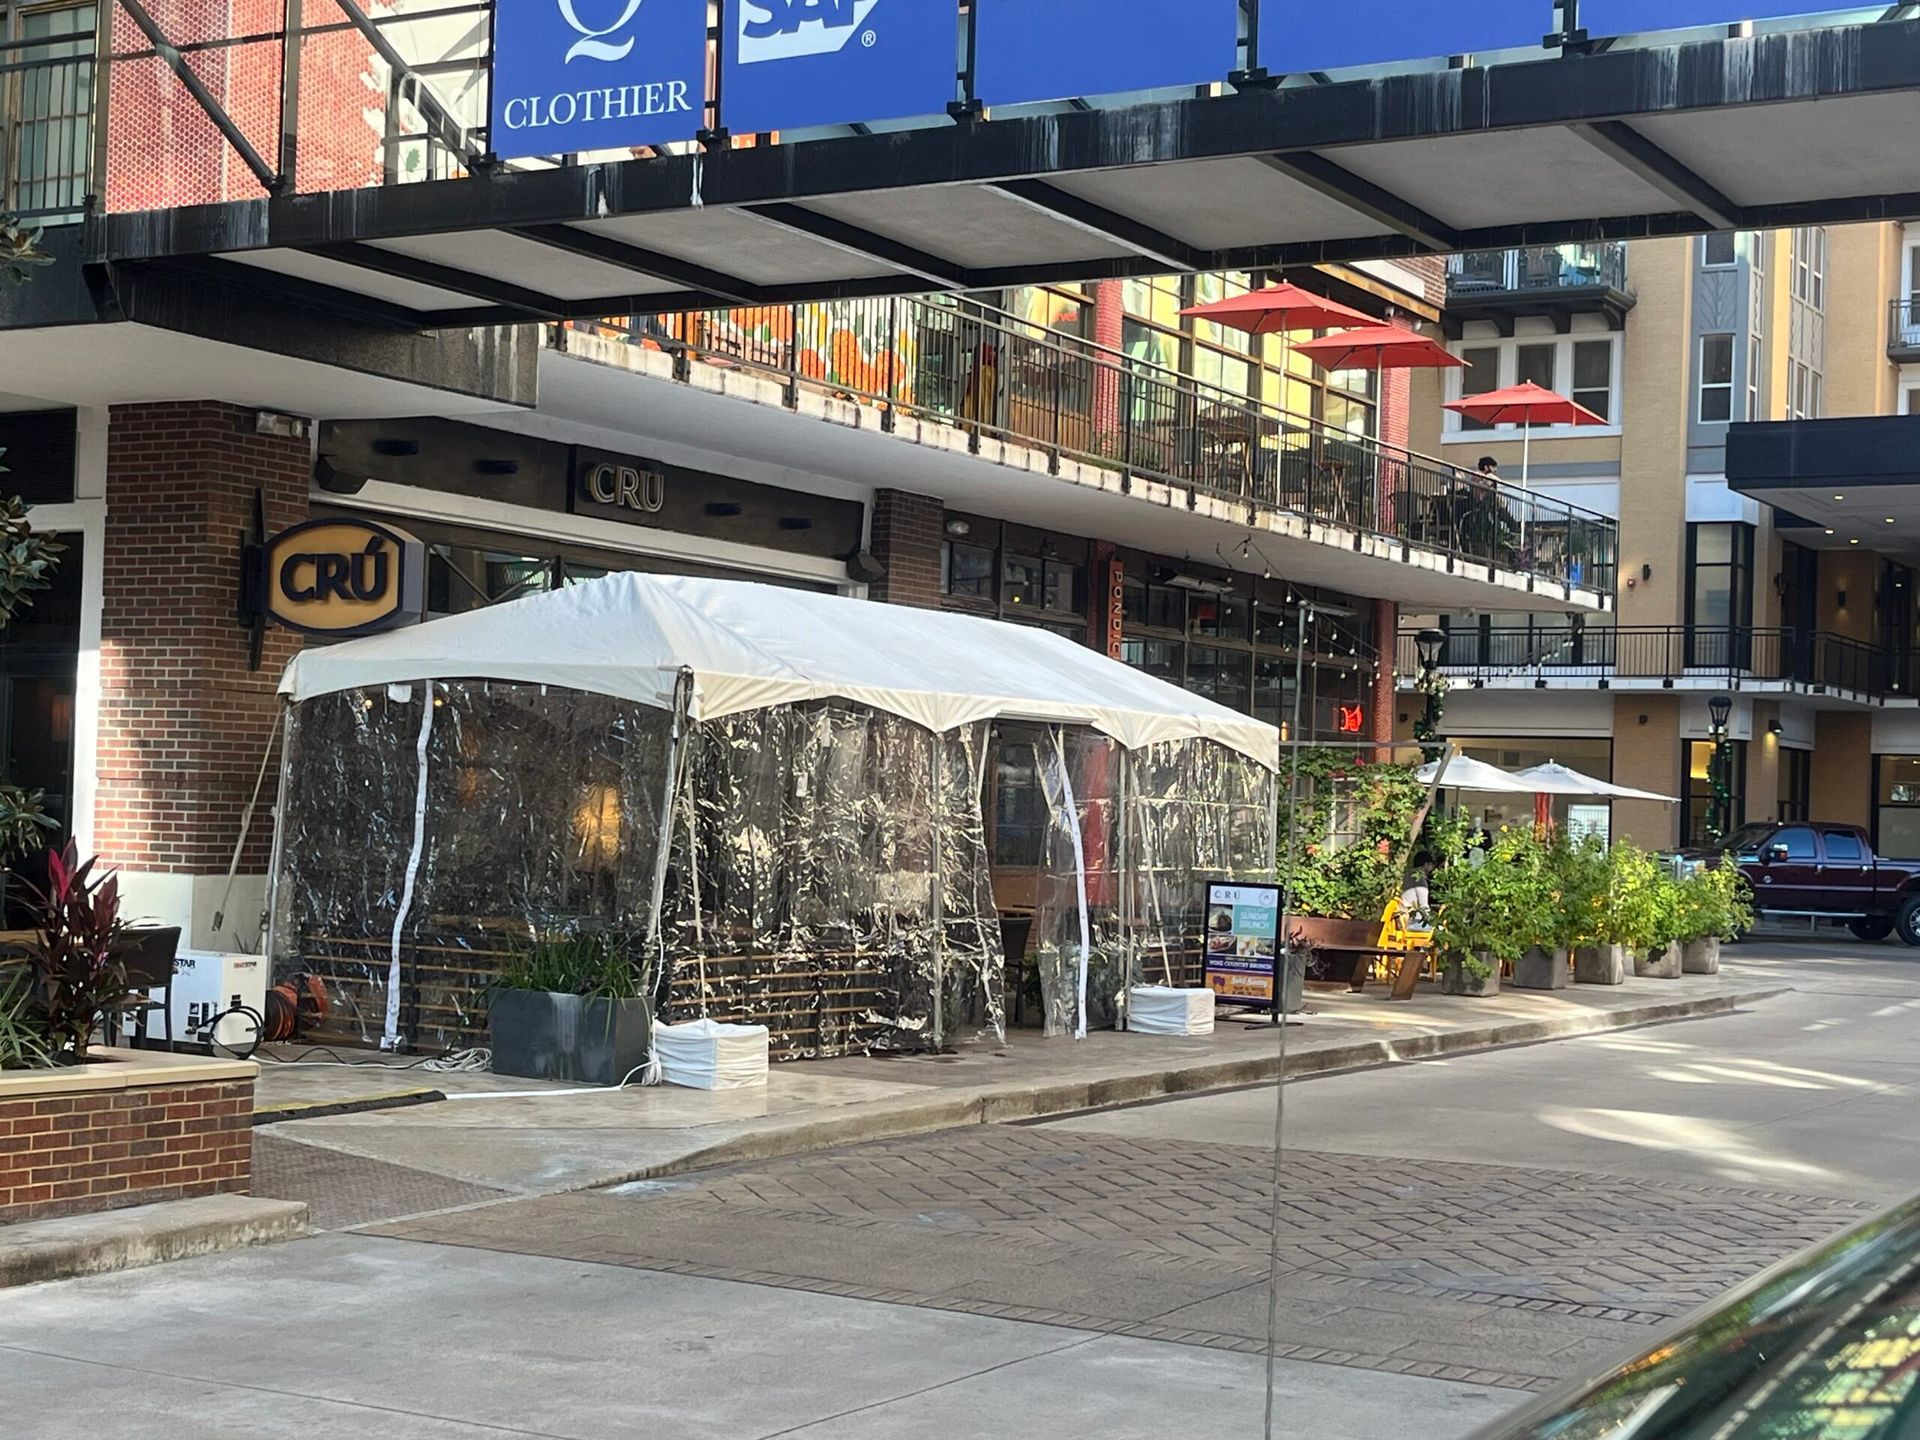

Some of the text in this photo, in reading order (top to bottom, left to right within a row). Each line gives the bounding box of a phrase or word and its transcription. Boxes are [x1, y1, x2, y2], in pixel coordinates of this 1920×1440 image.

[503, 80, 693, 130] CLOTHIER
[280, 535, 388, 603] CRÚ
[1112, 570, 1124, 661] PONDIC
